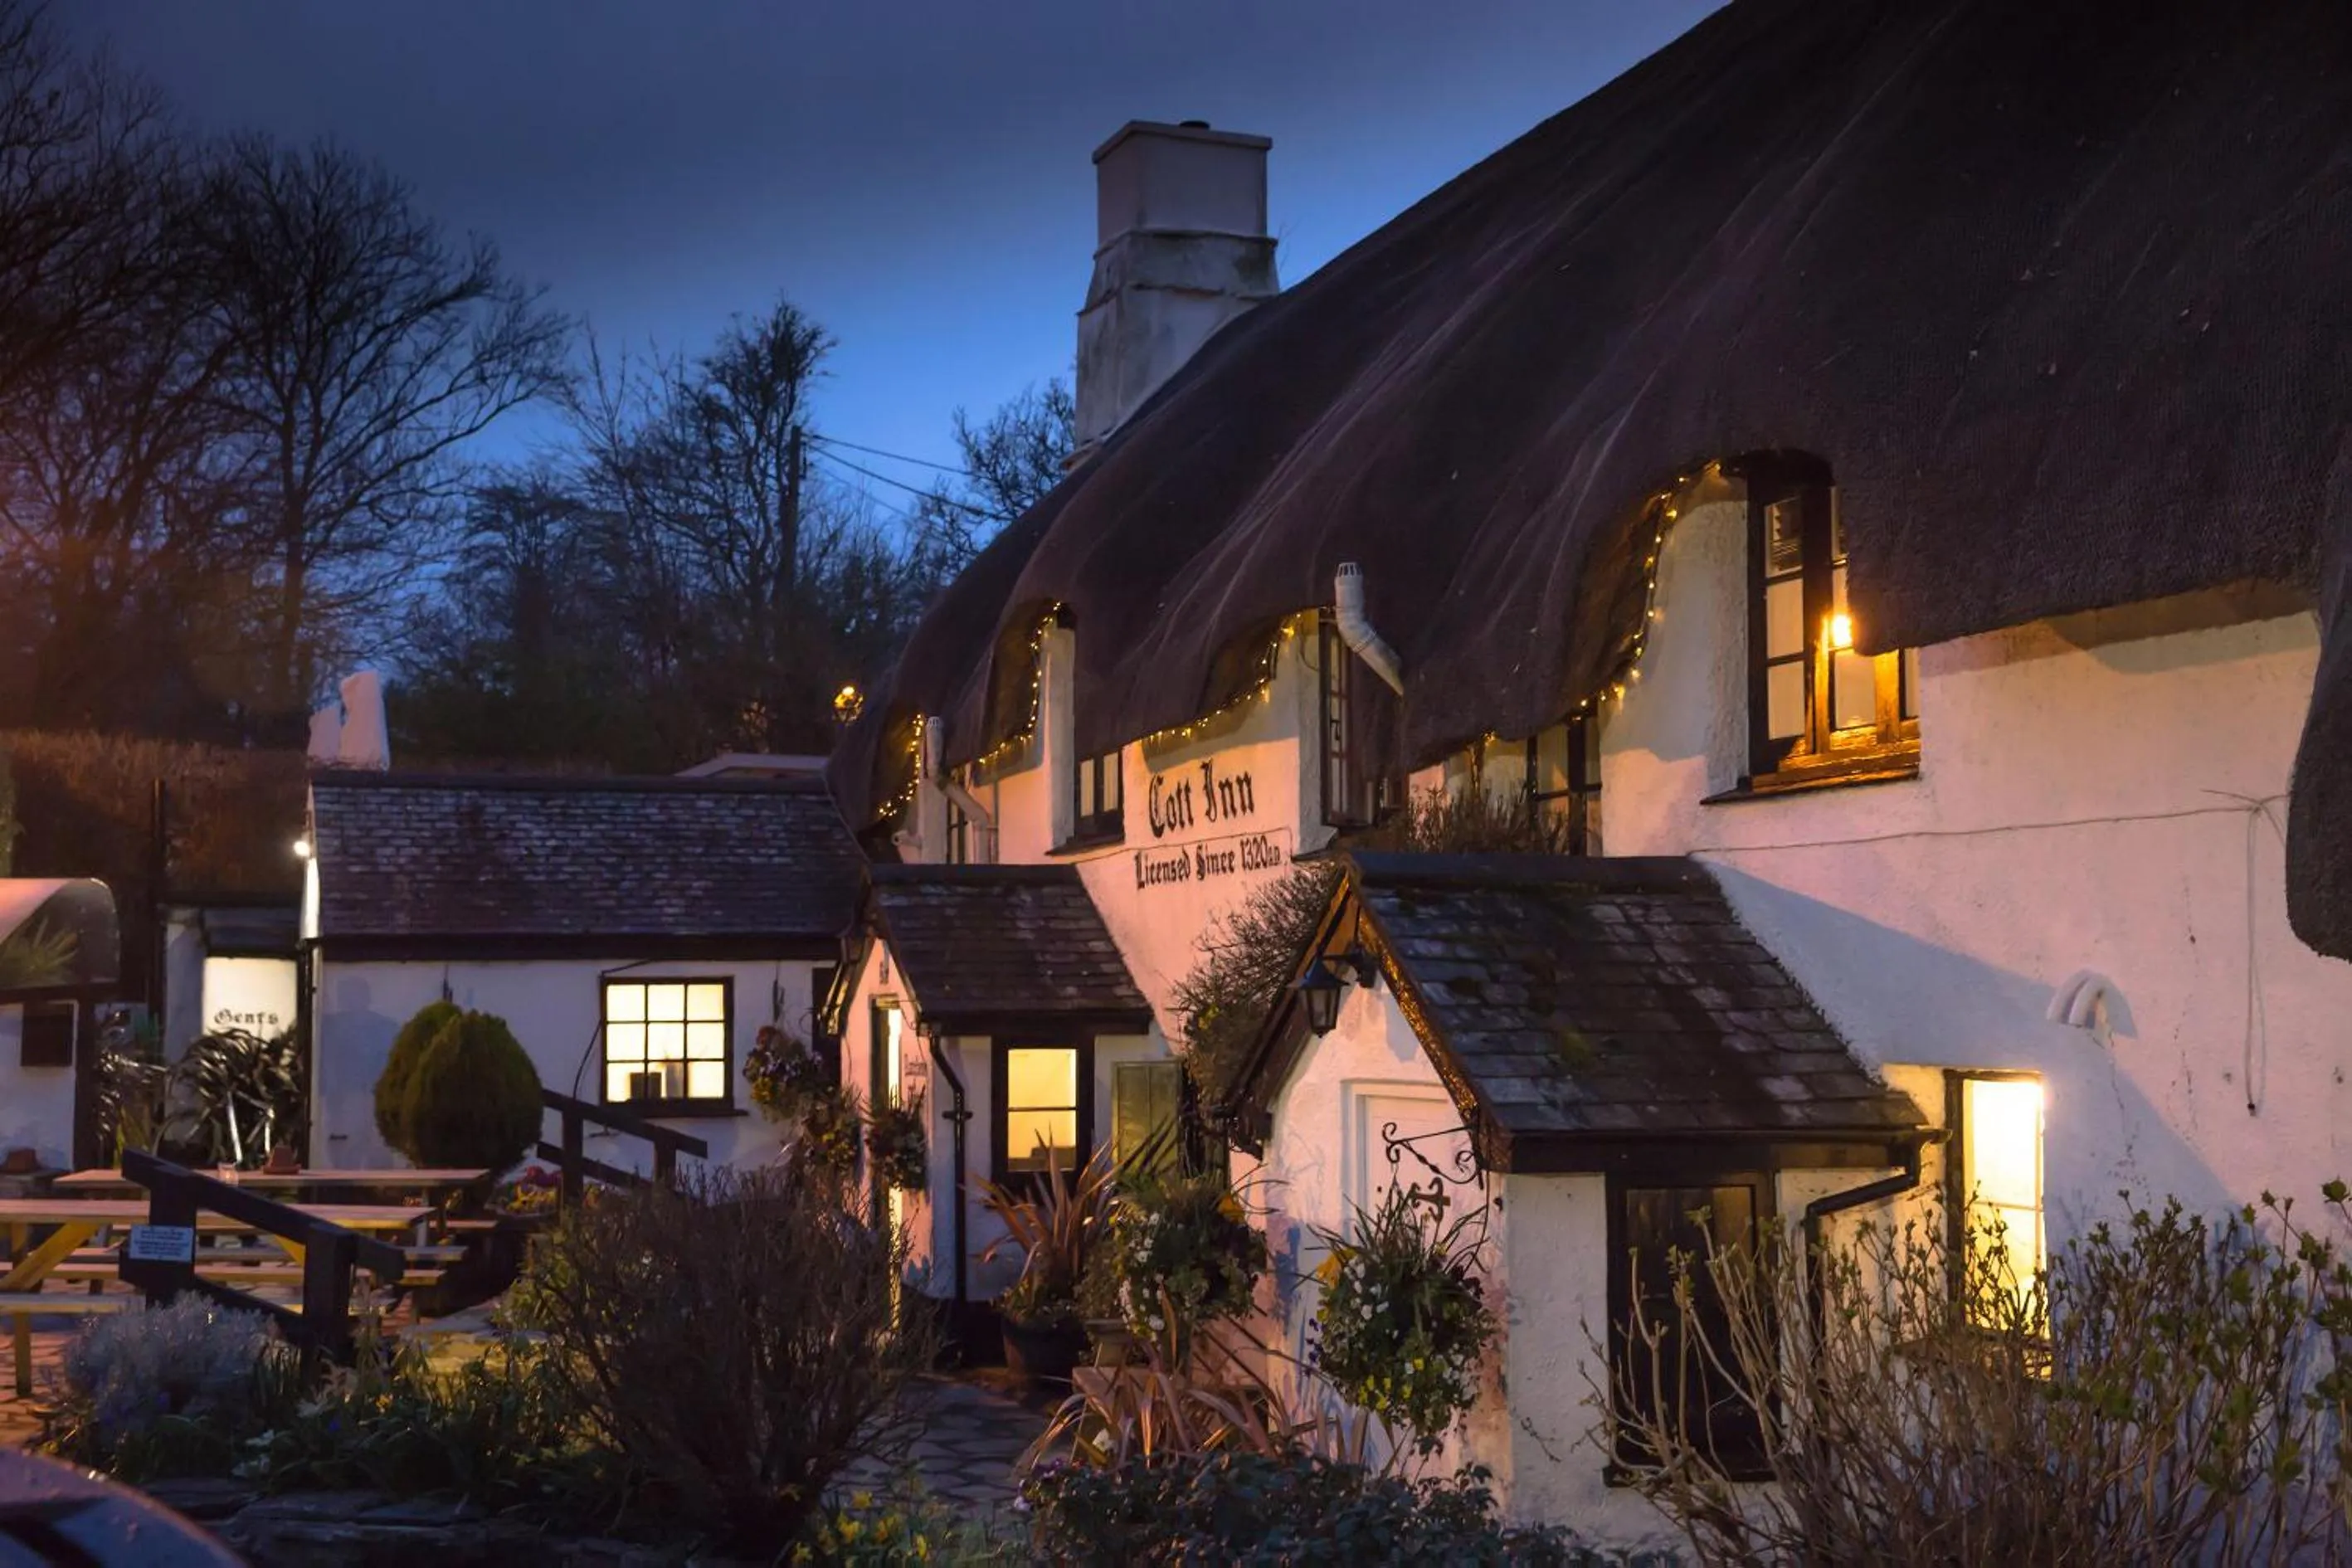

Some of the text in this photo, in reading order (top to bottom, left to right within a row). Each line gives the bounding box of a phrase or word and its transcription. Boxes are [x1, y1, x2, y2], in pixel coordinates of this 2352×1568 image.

[1149, 757, 1254, 838] Cott Inn
[1134, 845, 1191, 889] Licensed
[1196, 842, 1235, 881] Since
[213, 1008, 279, 1025] Gents
